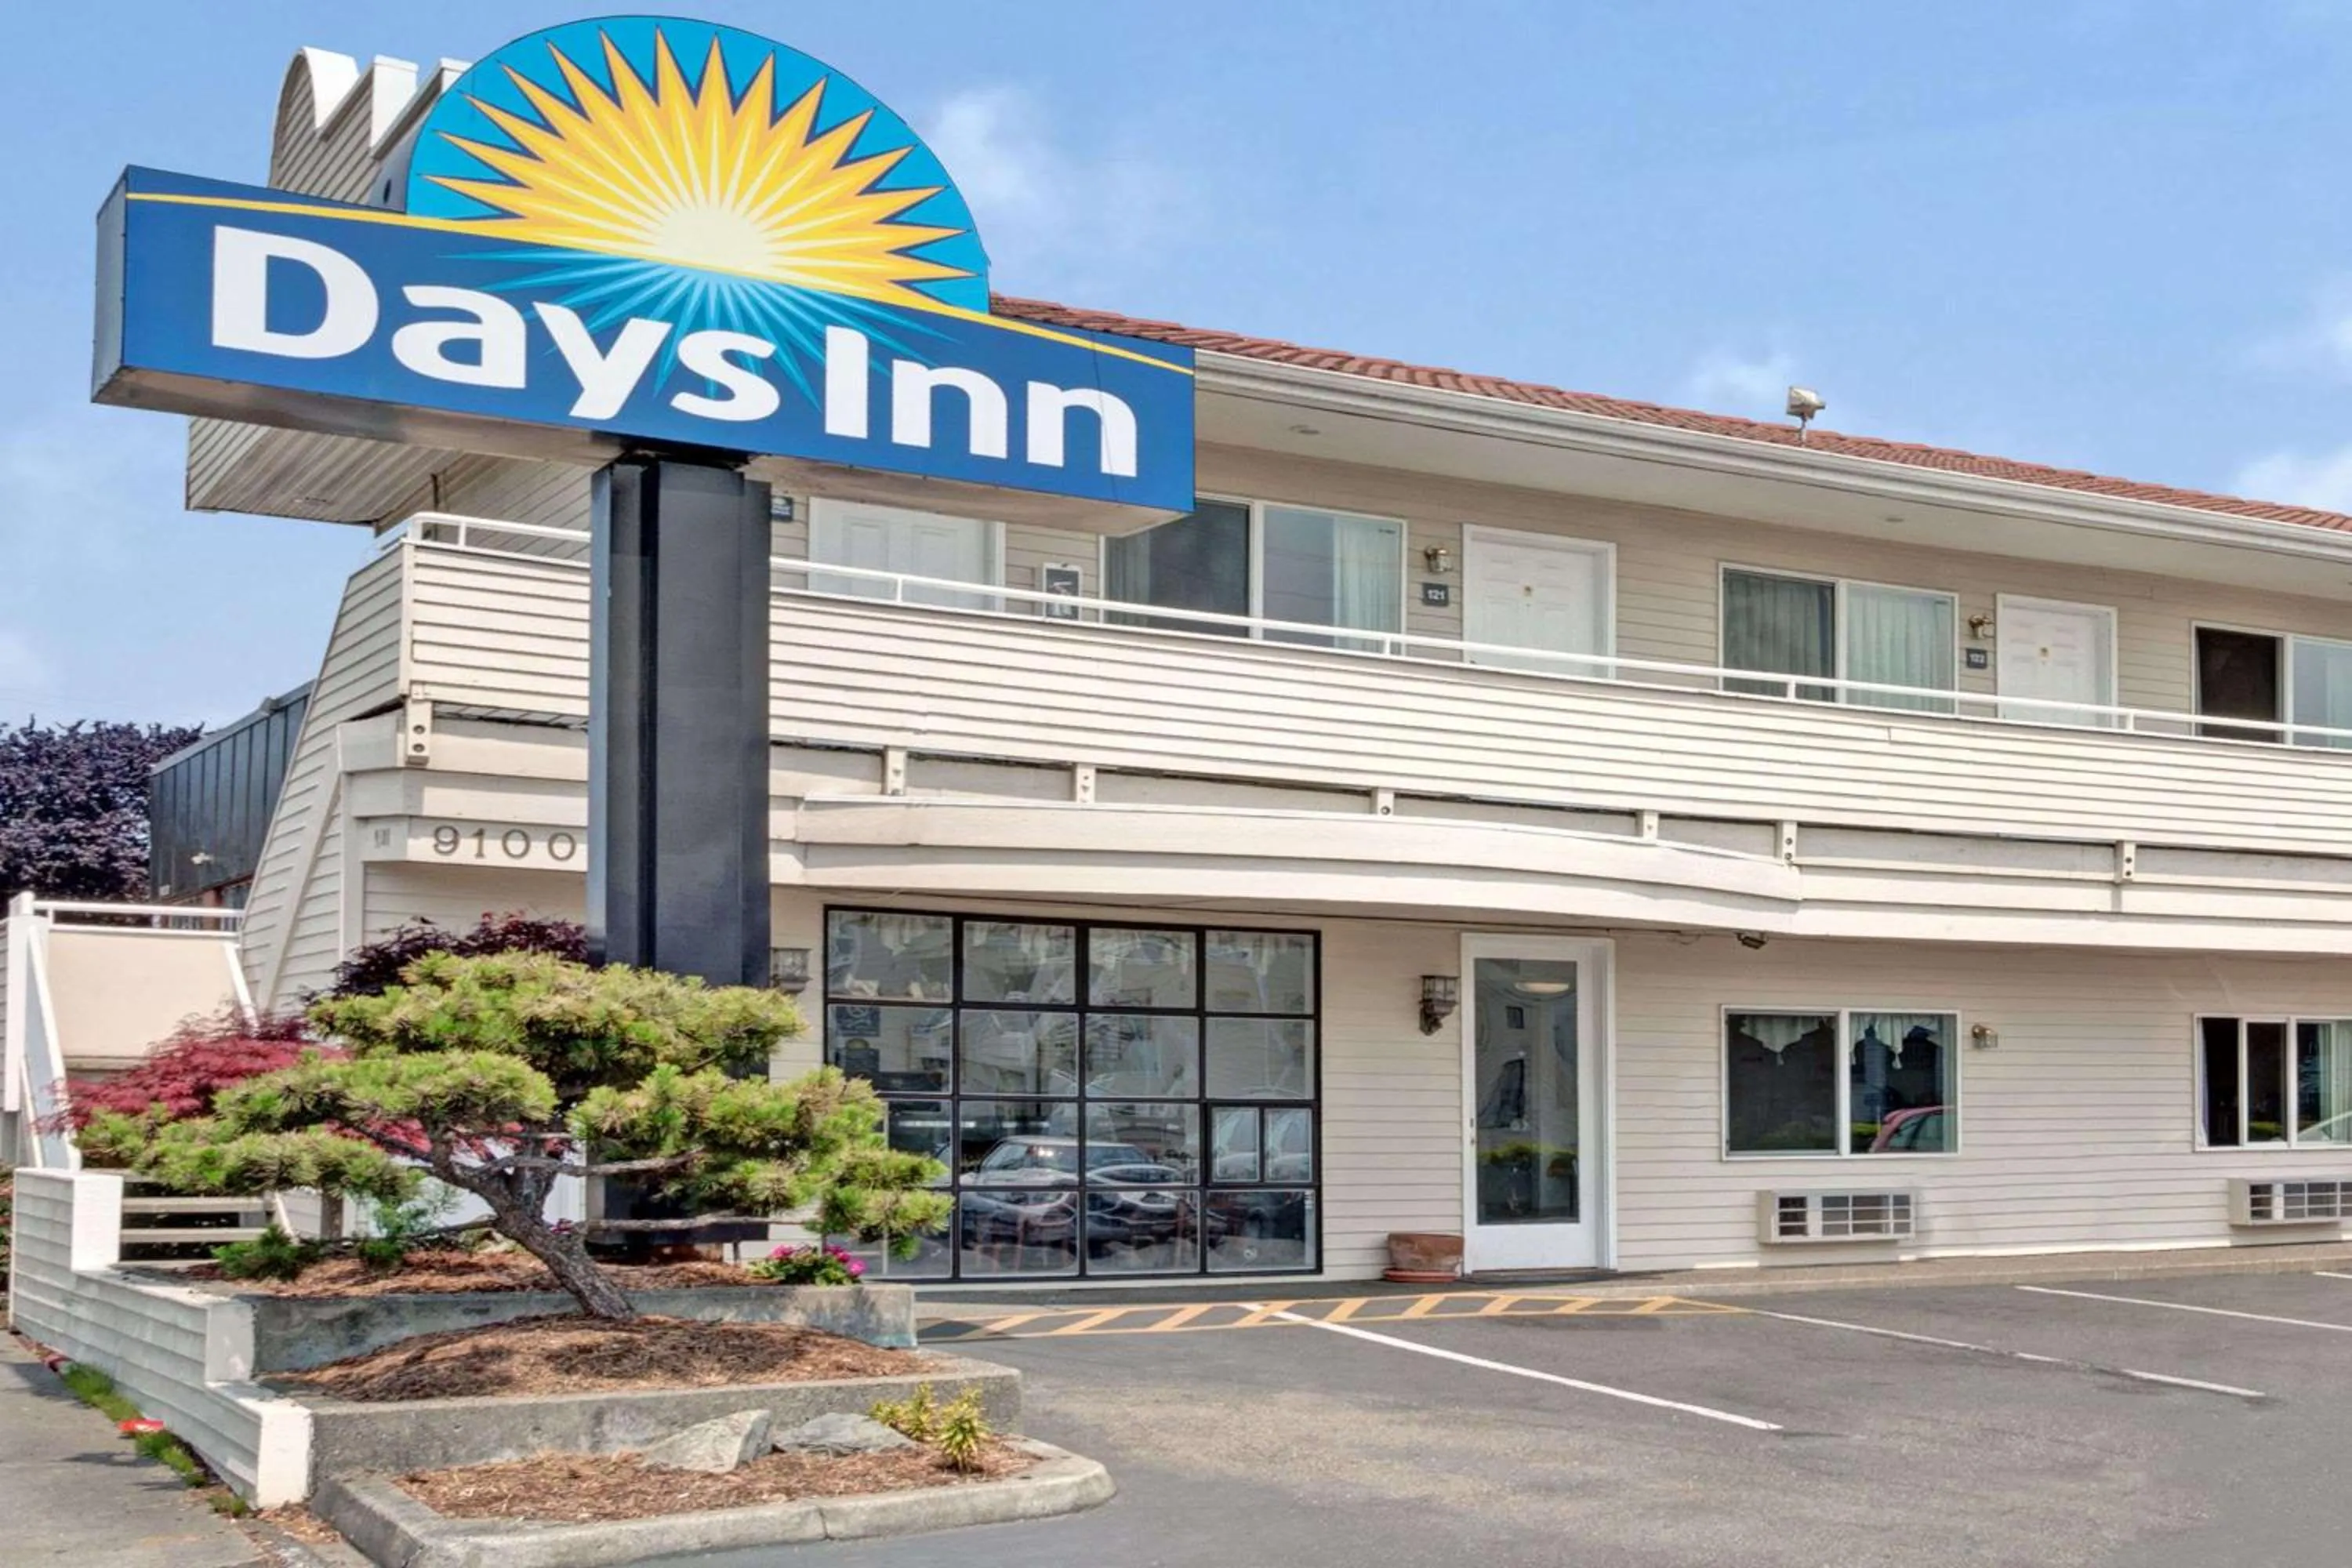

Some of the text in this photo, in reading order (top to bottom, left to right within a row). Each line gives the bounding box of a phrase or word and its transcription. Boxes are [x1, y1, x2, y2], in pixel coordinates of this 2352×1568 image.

[212, 225, 1138, 477] Days Inn
[434, 826, 577, 861] 9100
